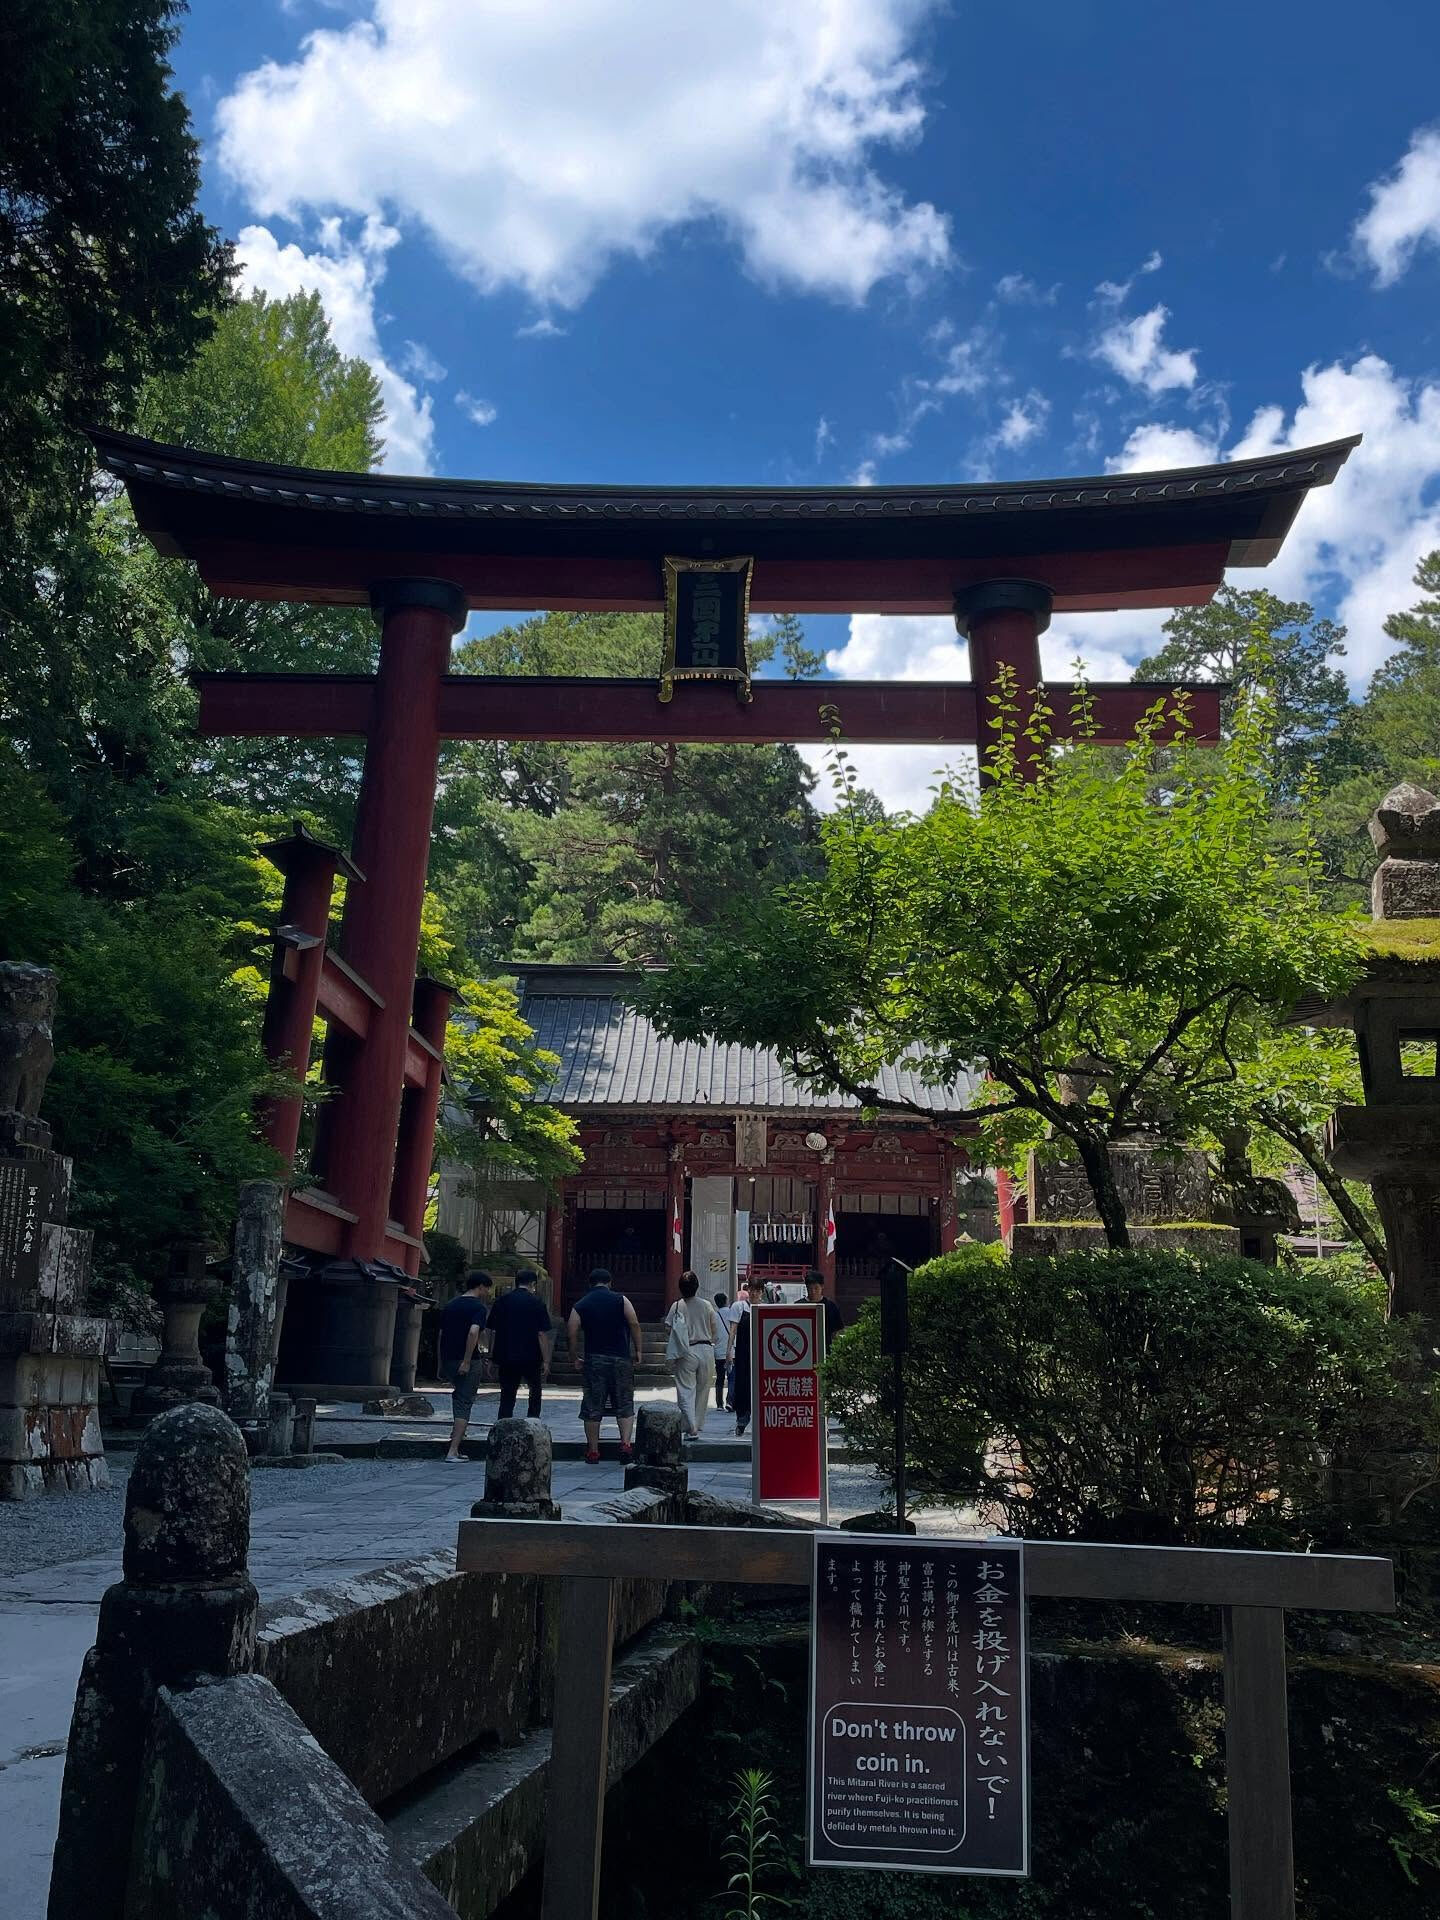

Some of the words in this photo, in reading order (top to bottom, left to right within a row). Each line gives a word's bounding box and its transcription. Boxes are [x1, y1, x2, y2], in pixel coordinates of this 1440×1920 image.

[764, 1376, 813, 1397] 火気厳禁
[764, 1405, 778, 1428] NO
[778, 1405, 814, 1416] OPEN
[778, 1416, 814, 1428] FLAME
[826, 1558, 838, 1592] ます。
[898, 1561, 912, 1653] 神聖な川です。
[873, 1559, 888, 1688] 投げ込まれたお金に
[832, 1718, 888, 1739] Don't
[893, 1720, 956, 1742] throw
[856, 1752, 899, 1772] coin
[905, 1753, 930, 1774] in.
[827, 1776, 846, 1786] This
[848, 1777, 876, 1788] Mitarai
[878, 1778, 900, 1788] River
[901, 1780, 909, 1789] is
[910, 1781, 916, 1789] a
[917, 1781, 946, 1791] sacred
[827, 1792, 846, 1801] river
[847, 1793, 874, 1802] where
[875, 1793, 905, 1804] Fuji-ko
[906, 1795, 959, 1806] practitioners
[827, 1807, 851, 1818] purify
[853, 1807, 902, 1818] themselves.
[904, 1809, 910, 1819] It
[912, 1811, 920, 1819] is
[921, 1811, 945, 1822] being
[827, 1821, 856, 1831] defiled
[857, 1822, 867, 1833] by
[869, 1823, 897, 1833] metals
[899, 1824, 928, 1835] thrown
[930, 1826, 947, 1836] into
[948, 1827, 957, 1837] it.
